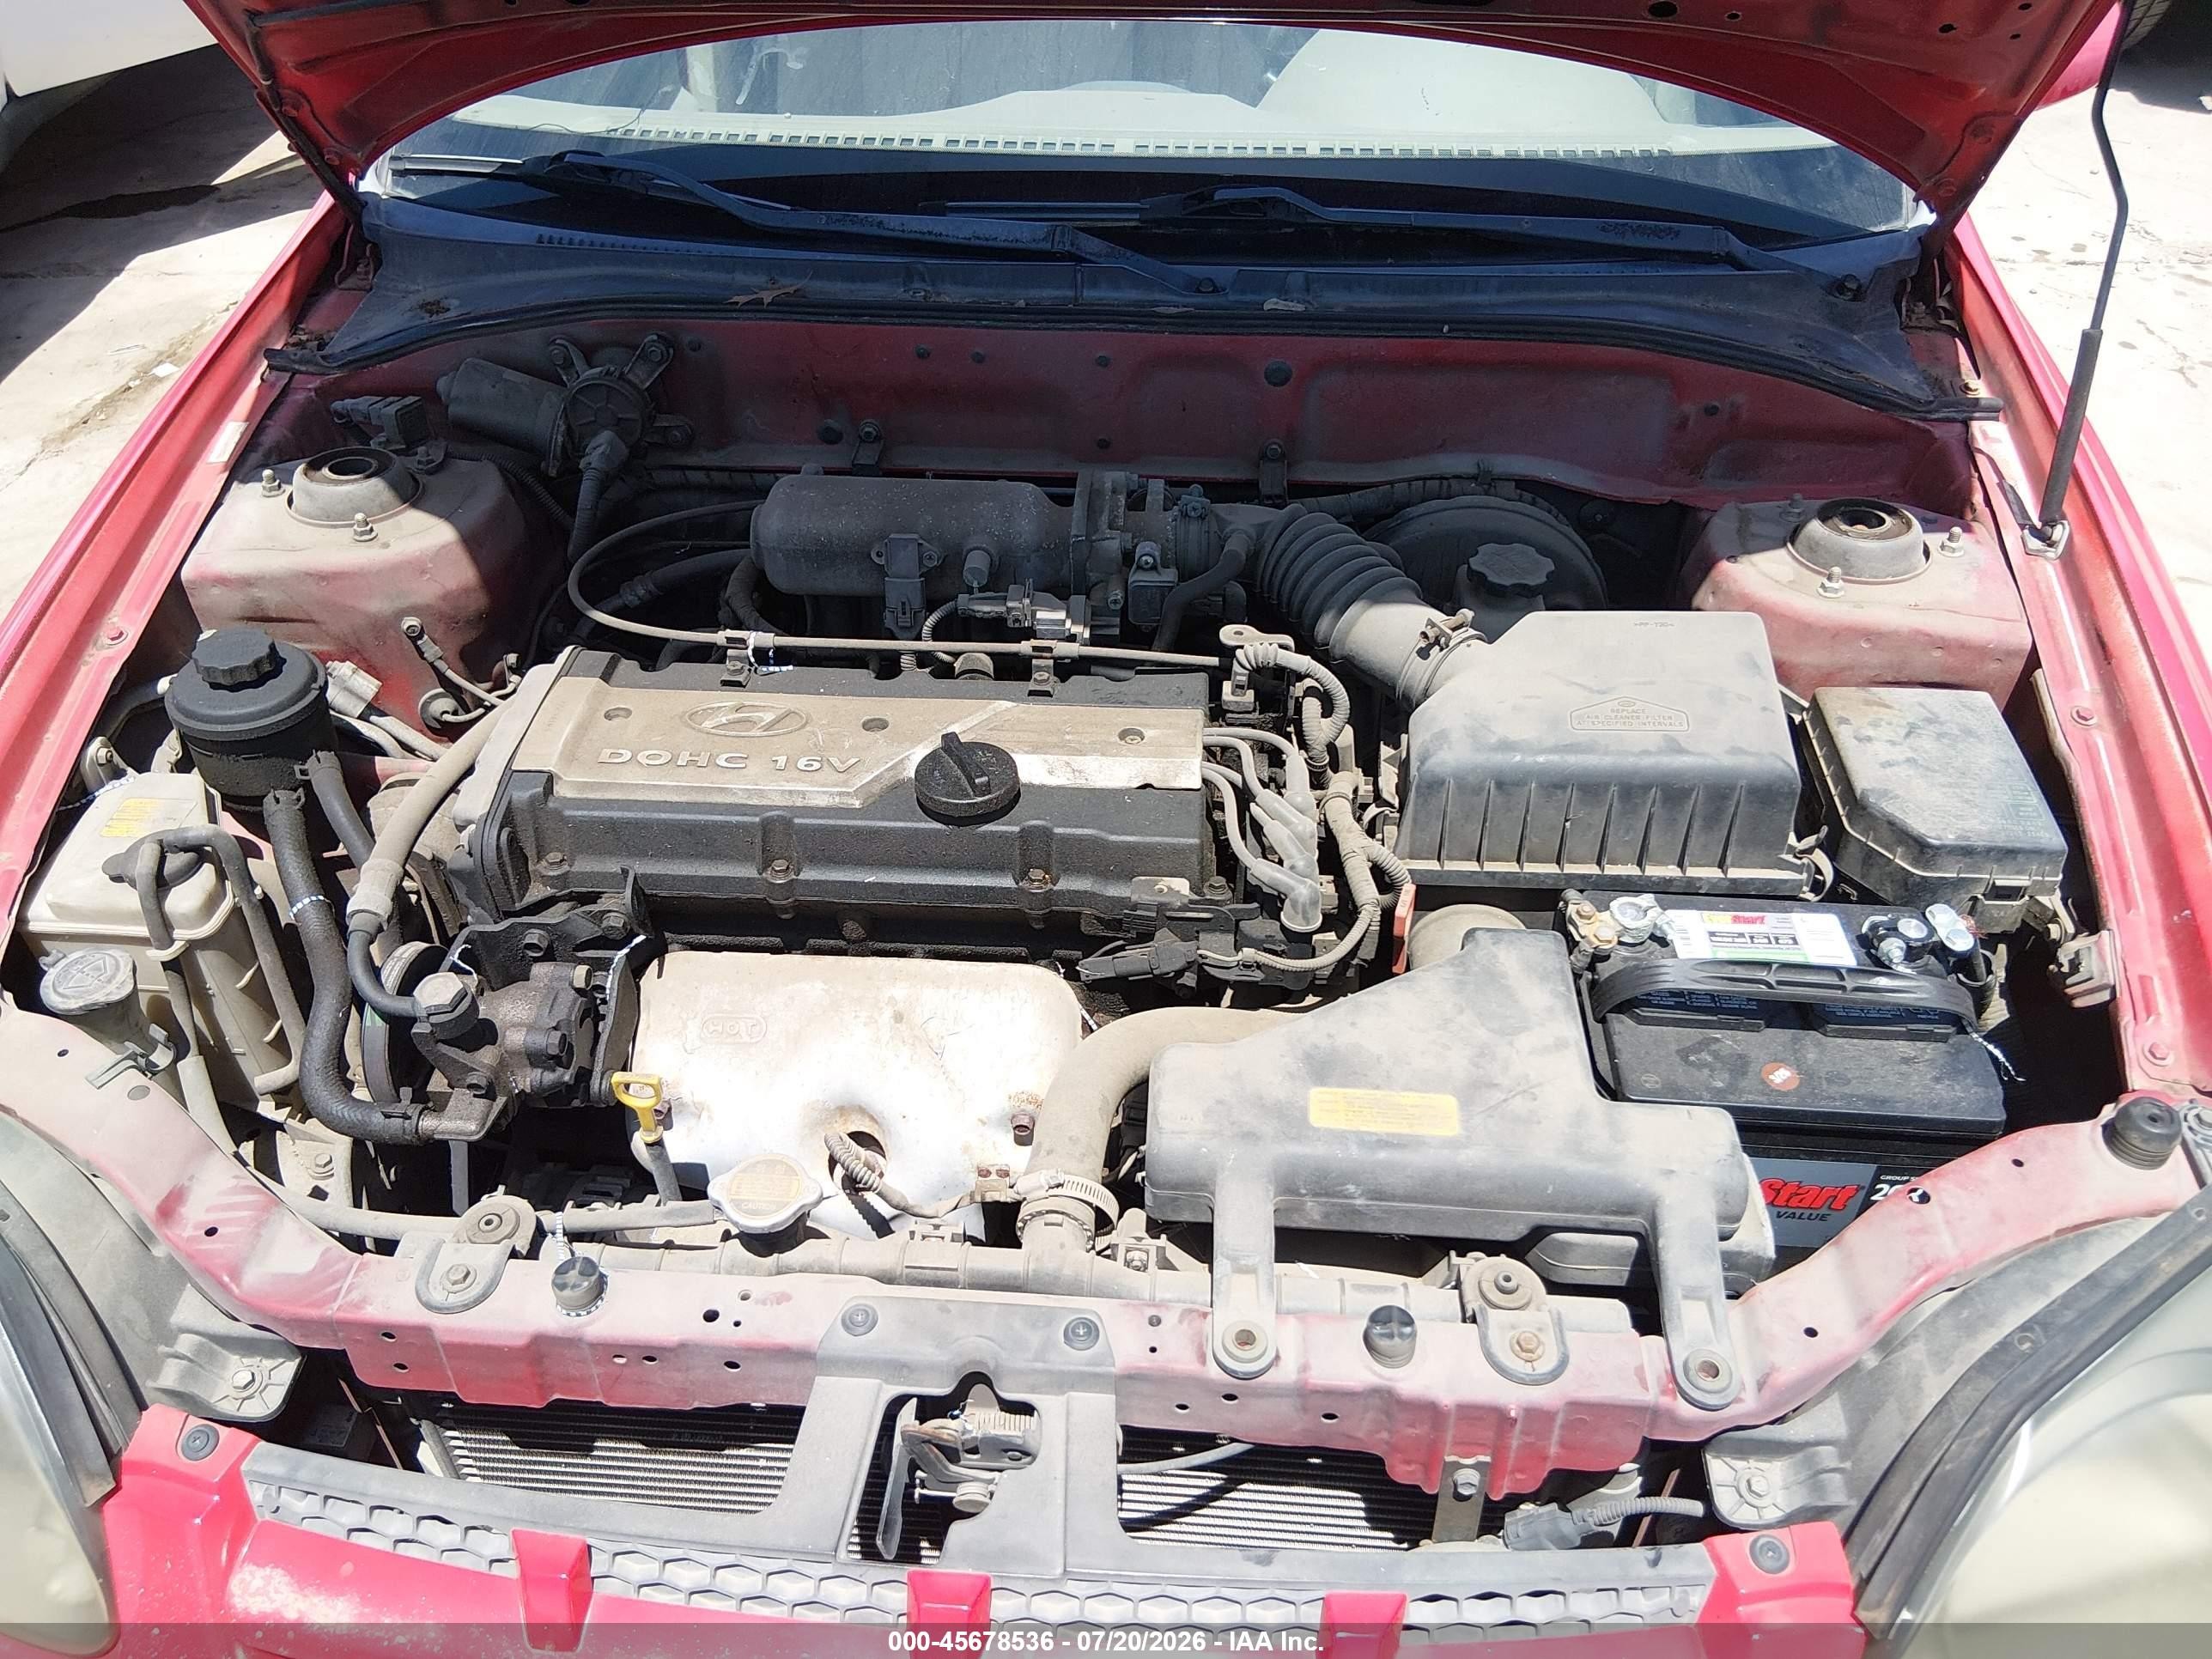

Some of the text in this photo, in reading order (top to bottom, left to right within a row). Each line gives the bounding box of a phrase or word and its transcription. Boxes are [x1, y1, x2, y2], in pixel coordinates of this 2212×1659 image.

[597, 748, 860, 774] DOHC 16V
[707, 1018, 757, 1037] HOT
[741, 1201, 777, 1210] CAUTION
[1776, 1210, 1832, 1221] VALUE
